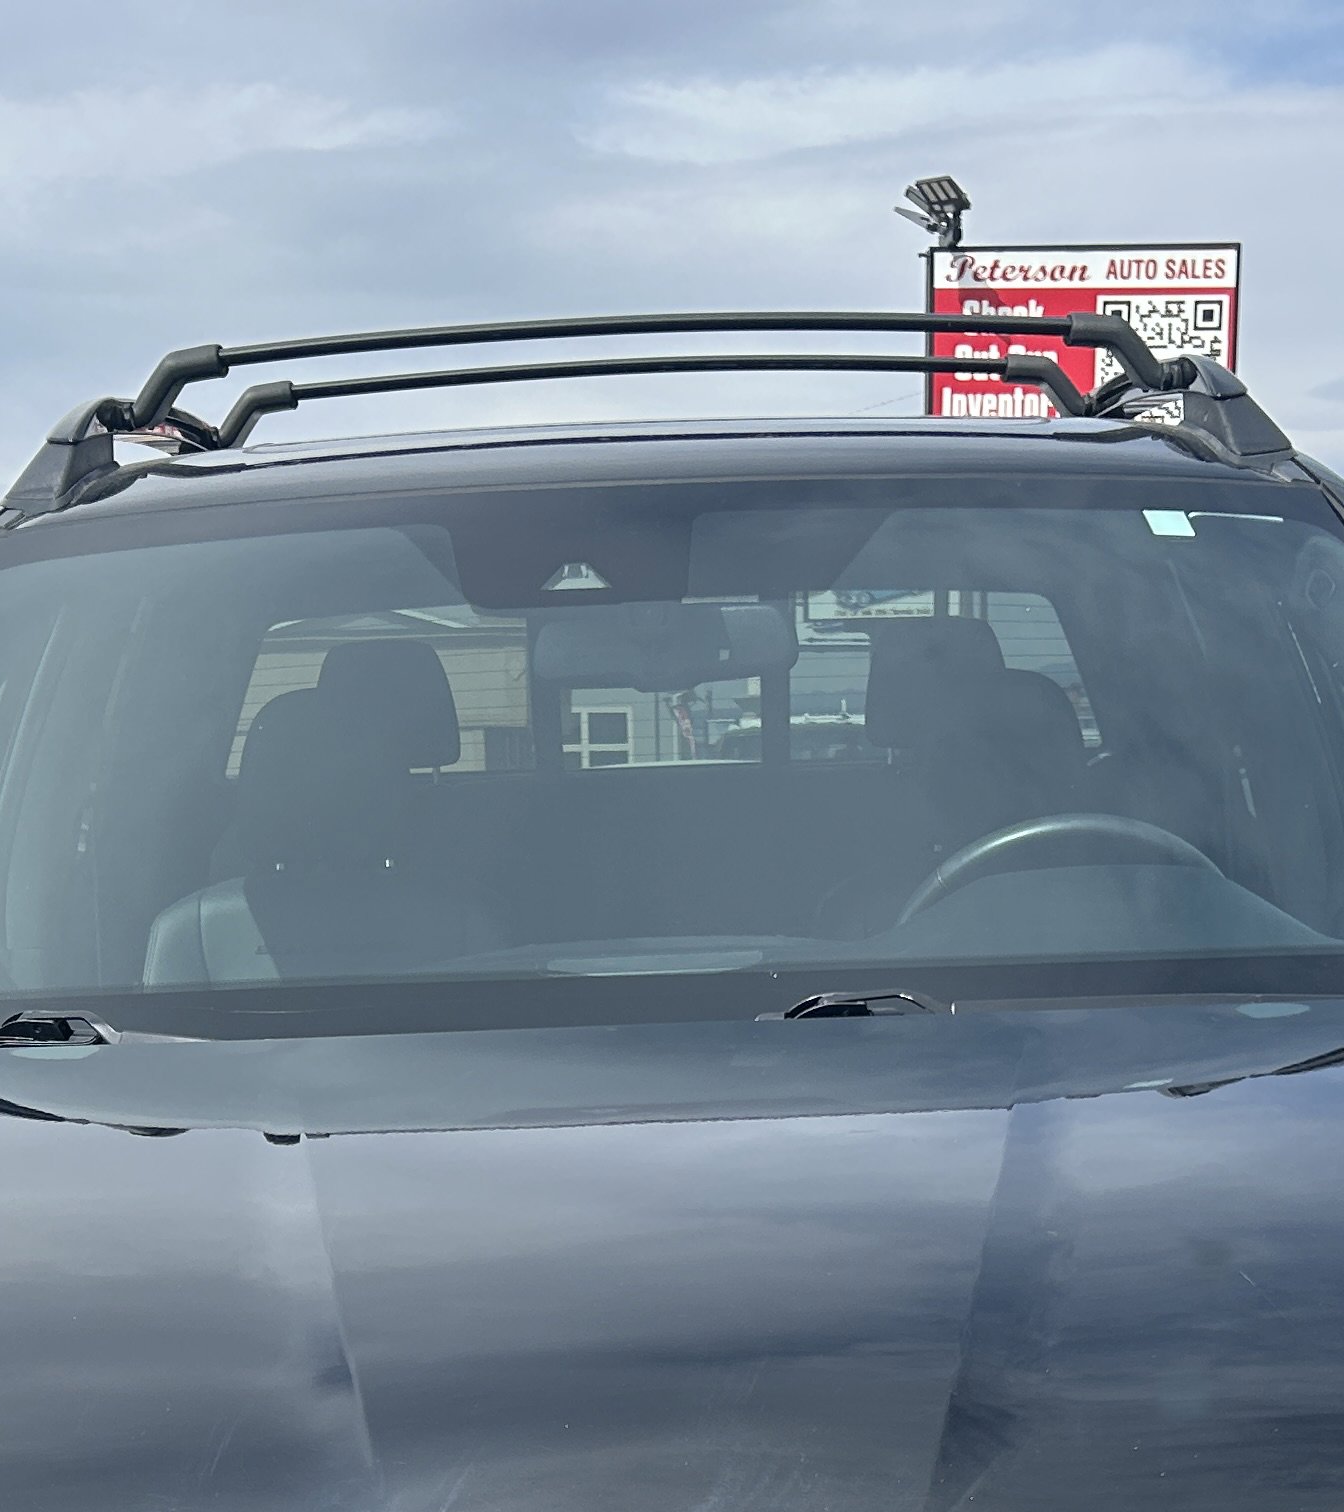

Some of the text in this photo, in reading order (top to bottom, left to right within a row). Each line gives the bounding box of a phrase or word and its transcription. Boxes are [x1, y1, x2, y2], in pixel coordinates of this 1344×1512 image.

[946, 255, 1226, 283] Peterson AUTO SALES
[941, 386, 1061, 417] Inventor
